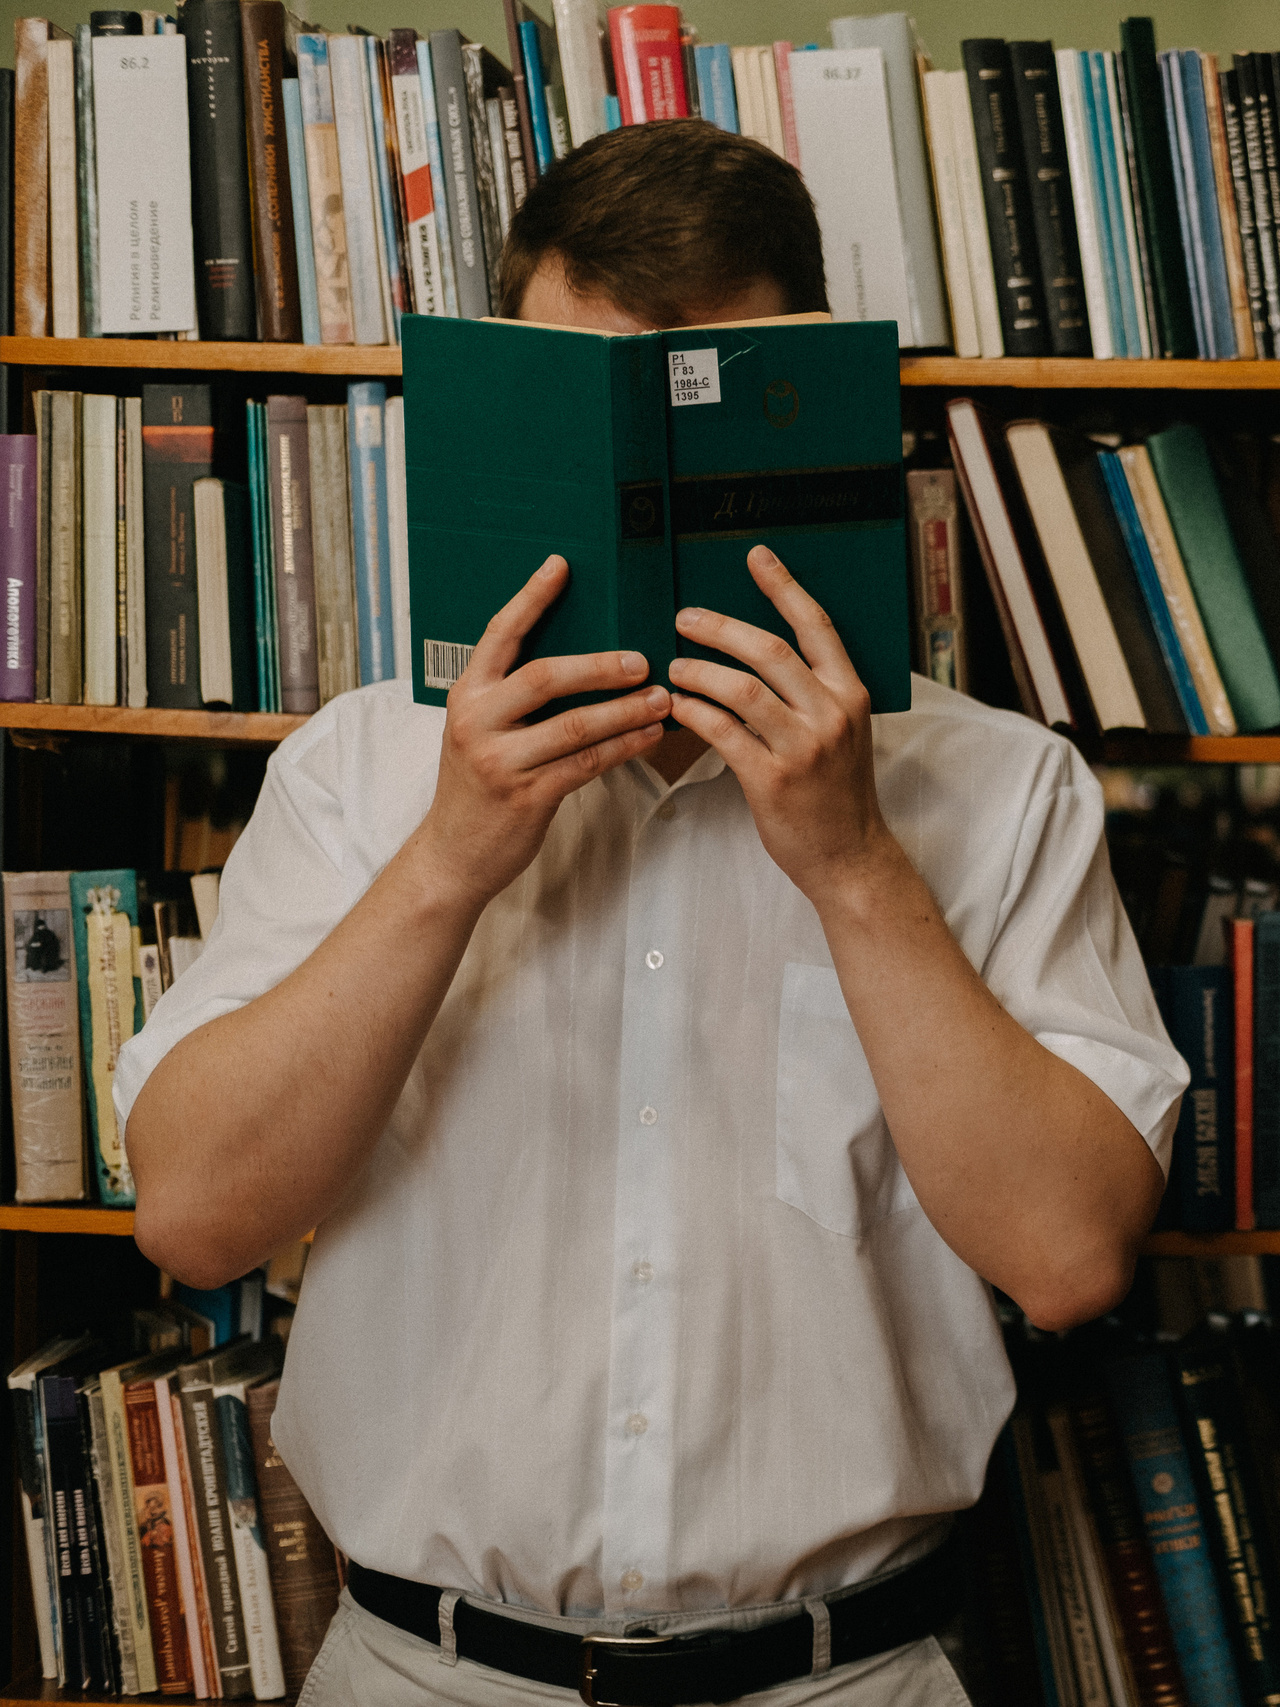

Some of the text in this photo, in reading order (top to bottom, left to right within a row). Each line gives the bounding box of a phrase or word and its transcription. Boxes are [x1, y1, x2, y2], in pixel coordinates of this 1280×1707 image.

[120, 56, 150, 70] 86.2
[823, 67, 862, 82] 86.37
[129, 199, 142, 248] целом
[148, 200, 162, 322] Религиоведение
[128, 258, 142, 322] Религия
[672, 354, 685, 363] Р1
[673, 365, 695, 376] Г 83
[674, 377, 709, 388] 1984-С
[675, 391, 699, 401] 1395
[209, 1508, 225, 1552] ИОАНН
[223, 1616, 238, 1654] Святой
